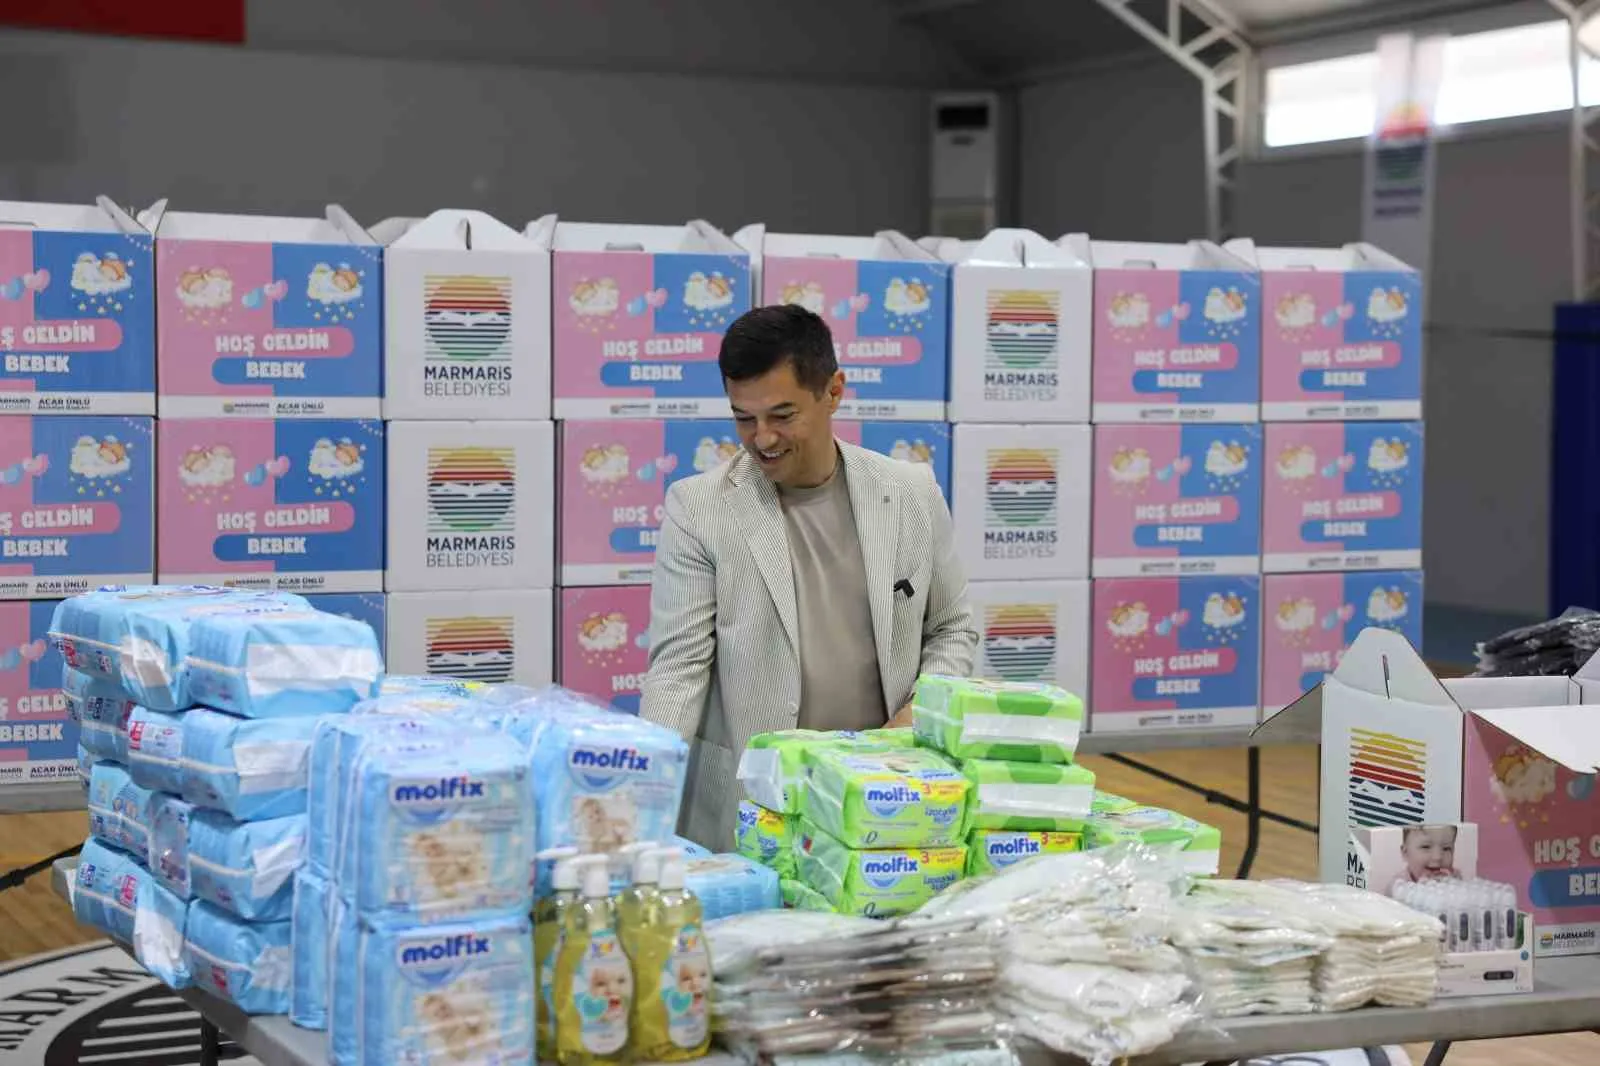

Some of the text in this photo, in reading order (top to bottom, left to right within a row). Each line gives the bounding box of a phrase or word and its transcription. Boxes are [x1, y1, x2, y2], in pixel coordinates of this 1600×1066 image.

[215, 333, 255, 357] HOŞ
[602, 340, 639, 361] HOŞ
[5, 355, 70, 374] BEBEK
[246, 361, 306, 379] BEBEK
[630, 364, 683, 381] BEBEK
[216, 512, 257, 534] HOŞ
[612, 505, 649, 526] HOŞ
[3, 538, 69, 558] BEBEK
[247, 537, 306, 555] BEBEK
[17, 694, 66, 714] GELD
[0, 723, 64, 742] BEBEK
[572, 747, 650, 771] molfix
[395, 775, 485, 801] molfix
[868, 786, 921, 803] molfix
[990, 838, 1040, 855] molfix
[1533, 836, 1581, 868] HOŞ
[865, 856, 918, 873] molfix
[402, 932, 491, 963] molfix
